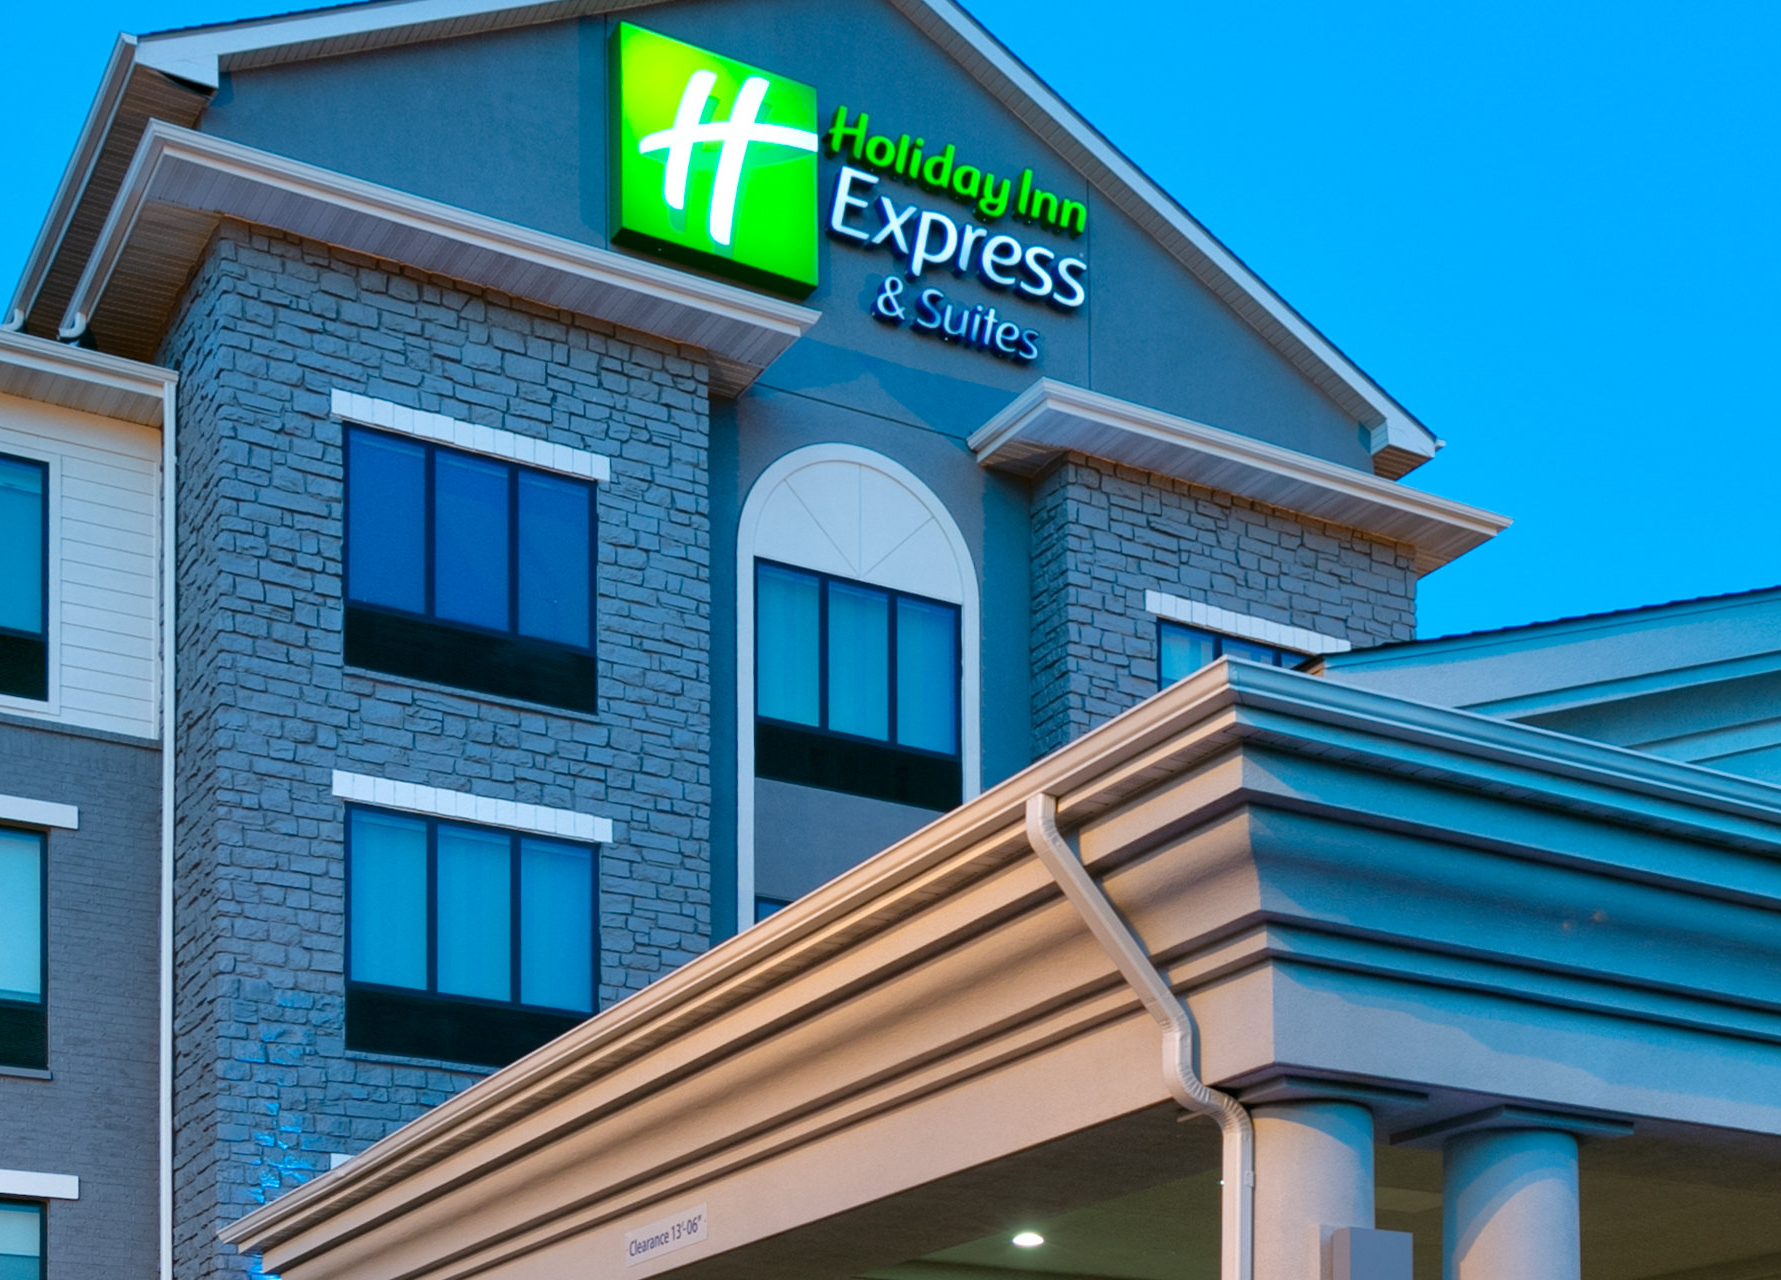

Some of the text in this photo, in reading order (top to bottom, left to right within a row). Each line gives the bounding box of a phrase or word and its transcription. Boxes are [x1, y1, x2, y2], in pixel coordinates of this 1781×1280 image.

[827, 105, 1087, 234] Holiday Inn
[829, 166, 1087, 307] Express
[876, 276, 1039, 361] & Suites
[629, 1231, 669, 1257] Clearance
